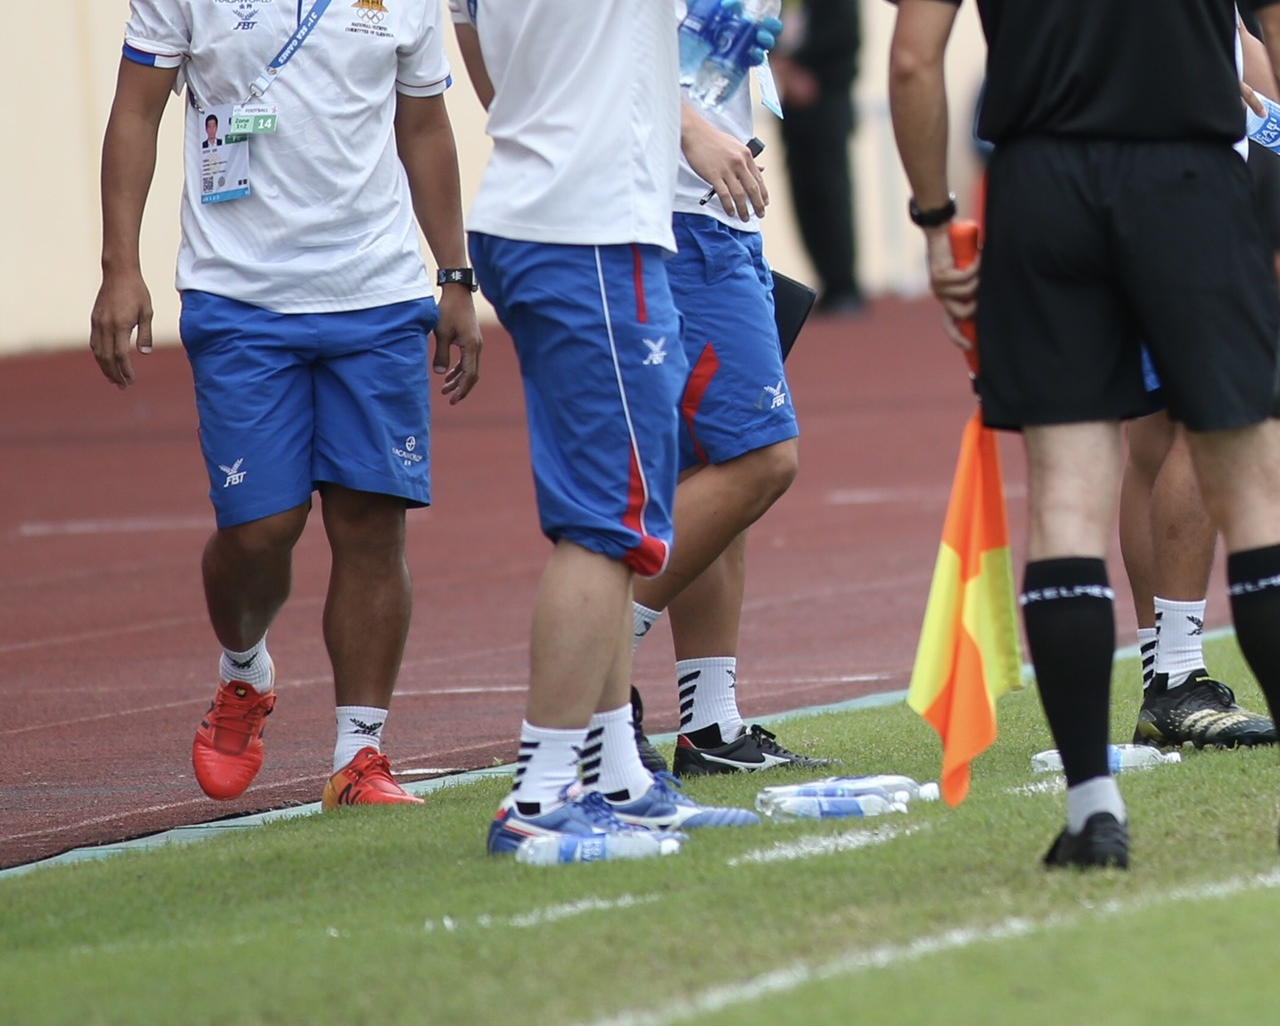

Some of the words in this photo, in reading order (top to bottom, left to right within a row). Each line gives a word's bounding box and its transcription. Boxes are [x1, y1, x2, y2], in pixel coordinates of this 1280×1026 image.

[233, 21, 258, 30] FBT
[278, 39, 298, 64] GAMES
[258, 118, 272, 129] 14
[223, 471, 247, 488] FBT
[1027, 584, 1104, 602] KELME
